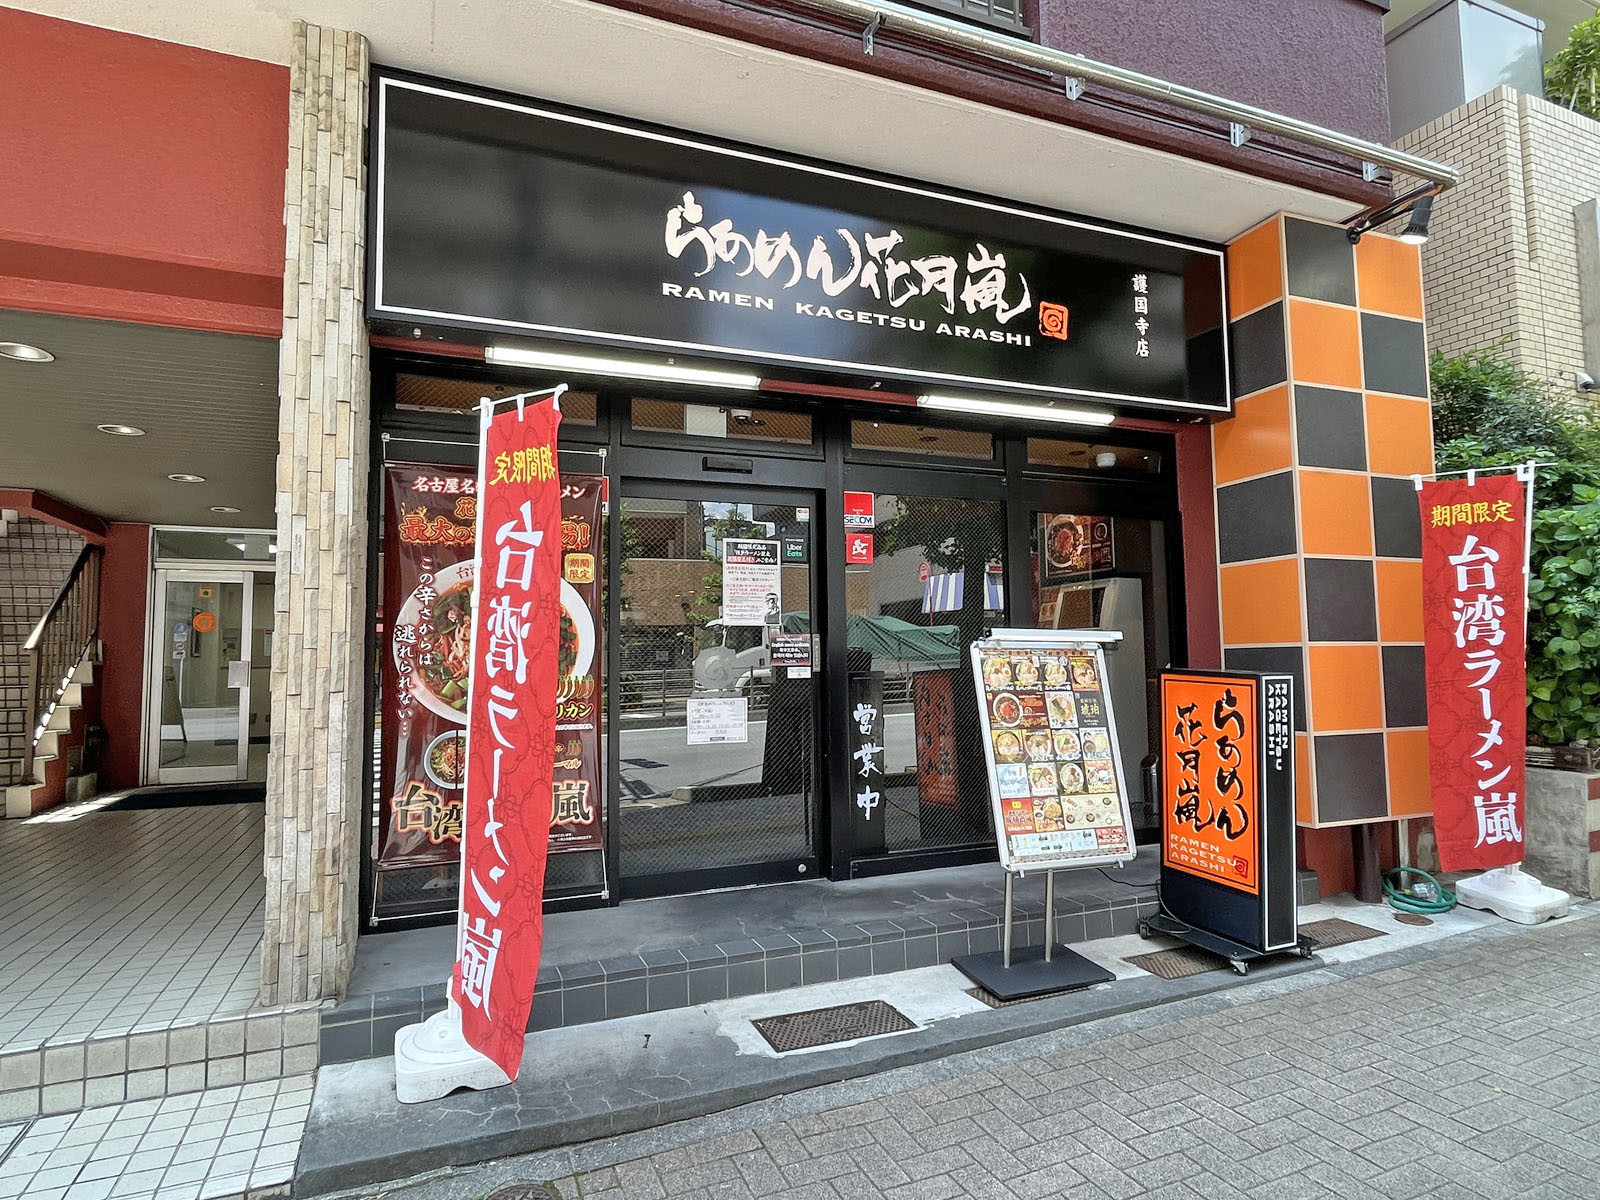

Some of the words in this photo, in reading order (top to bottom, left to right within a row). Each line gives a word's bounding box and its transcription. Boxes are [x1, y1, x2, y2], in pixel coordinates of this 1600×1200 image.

[665, 190, 1031, 325] らあめん花月嵐
[661, 282, 775, 311] RAMEN
[795, 302, 927, 332] KAGETSU
[936, 322, 1032, 347] ARASHI
[1132, 273, 1150, 358] 護国寺店
[412, 476, 478, 494] 名古屋名
[456, 497, 476, 518] 花
[844, 515, 873, 525] SECOM
[1432, 500, 1516, 528] 期間限定
[403, 516, 475, 542] 最大の
[786, 543, 803, 551] Uber
[569, 558, 590, 569] 期間
[569, 569, 590, 579] 限定
[416, 557, 437, 665] この辛さからは
[1448, 534, 1523, 850] 台湾ラーメン嵐
[1281, 683, 1289, 749] RAMEN
[853, 703, 884, 821] 営業中
[1173, 702, 1215, 833] 花月嵐
[1212, 687, 1249, 841] らあめん
[1170, 833, 1220, 853] RAMEN
[1170, 842, 1237, 867] KAGETSU
[1171, 851, 1225, 873] ARASHI
